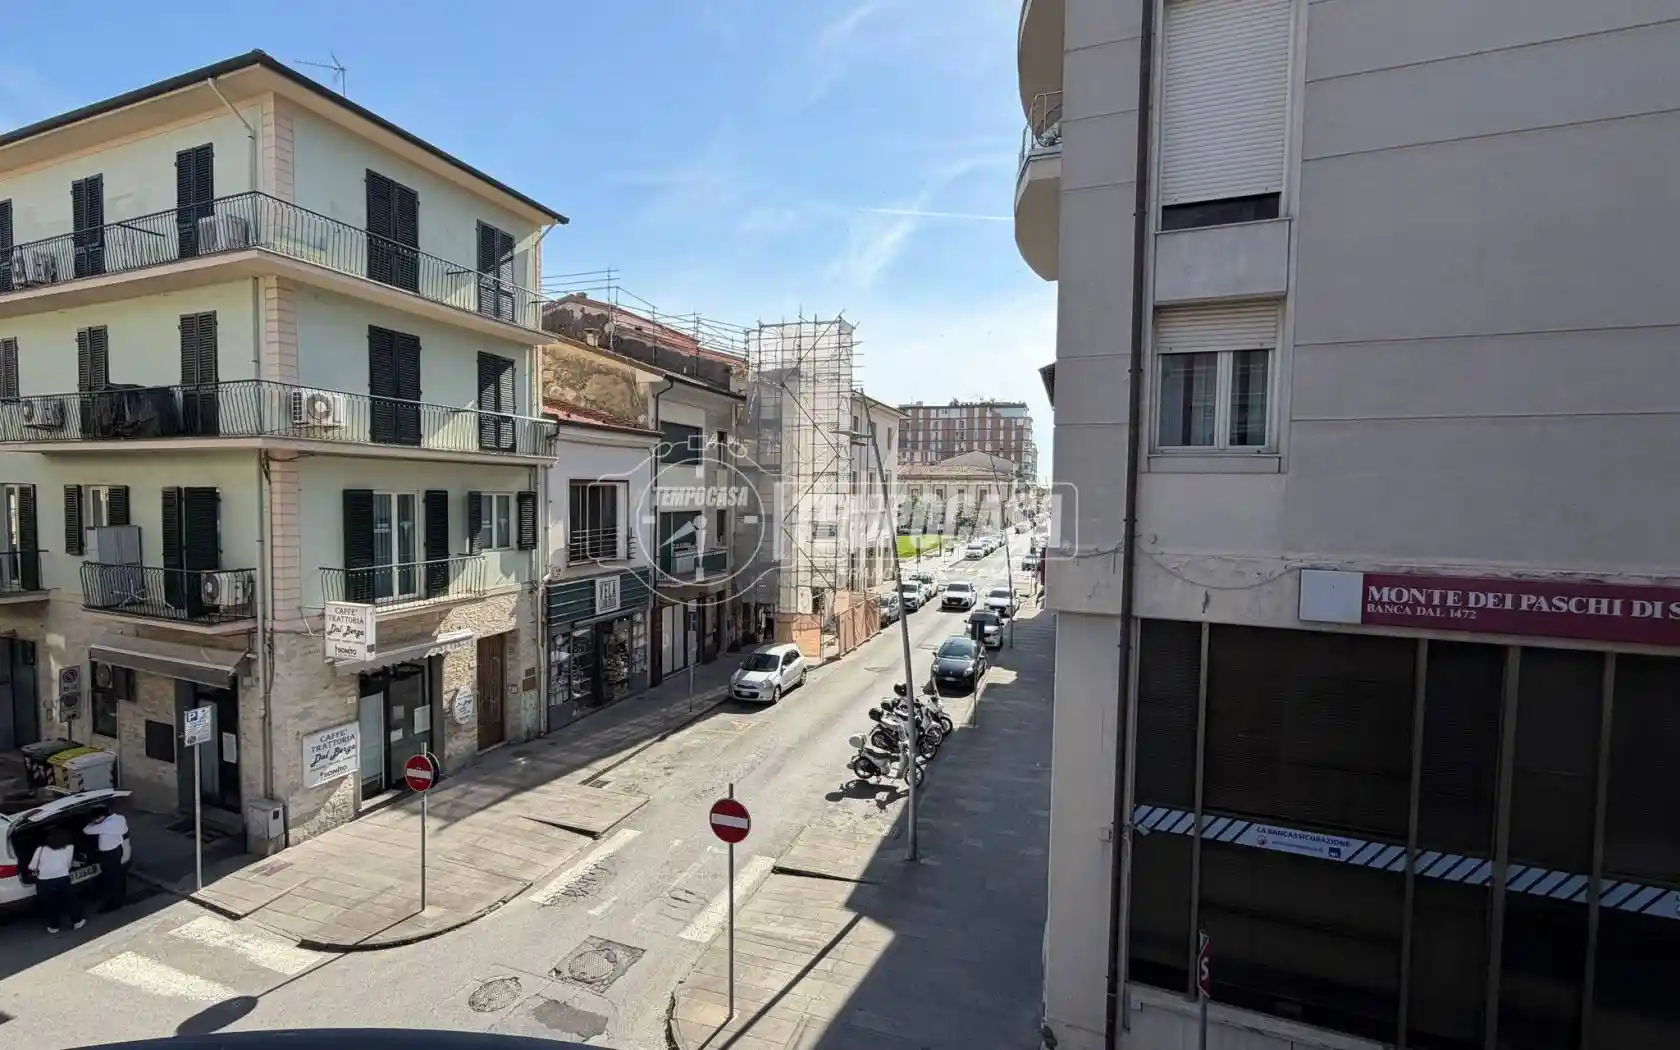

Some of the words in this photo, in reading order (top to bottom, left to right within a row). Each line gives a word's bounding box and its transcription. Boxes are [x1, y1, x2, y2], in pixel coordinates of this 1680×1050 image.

[1368, 585, 1463, 607] MONTE
[1468, 591, 1514, 610] DEI
[1519, 594, 1624, 616] PASCHI
[1630, 600, 1664, 619] DI
[1367, 603, 1412, 615] BANCA
[1416, 606, 1445, 617] DAL
[1450, 608, 1476, 619] 1472
[327, 615, 364, 625] TRATTORIA
[310, 734, 355, 753] TRATTORIA
